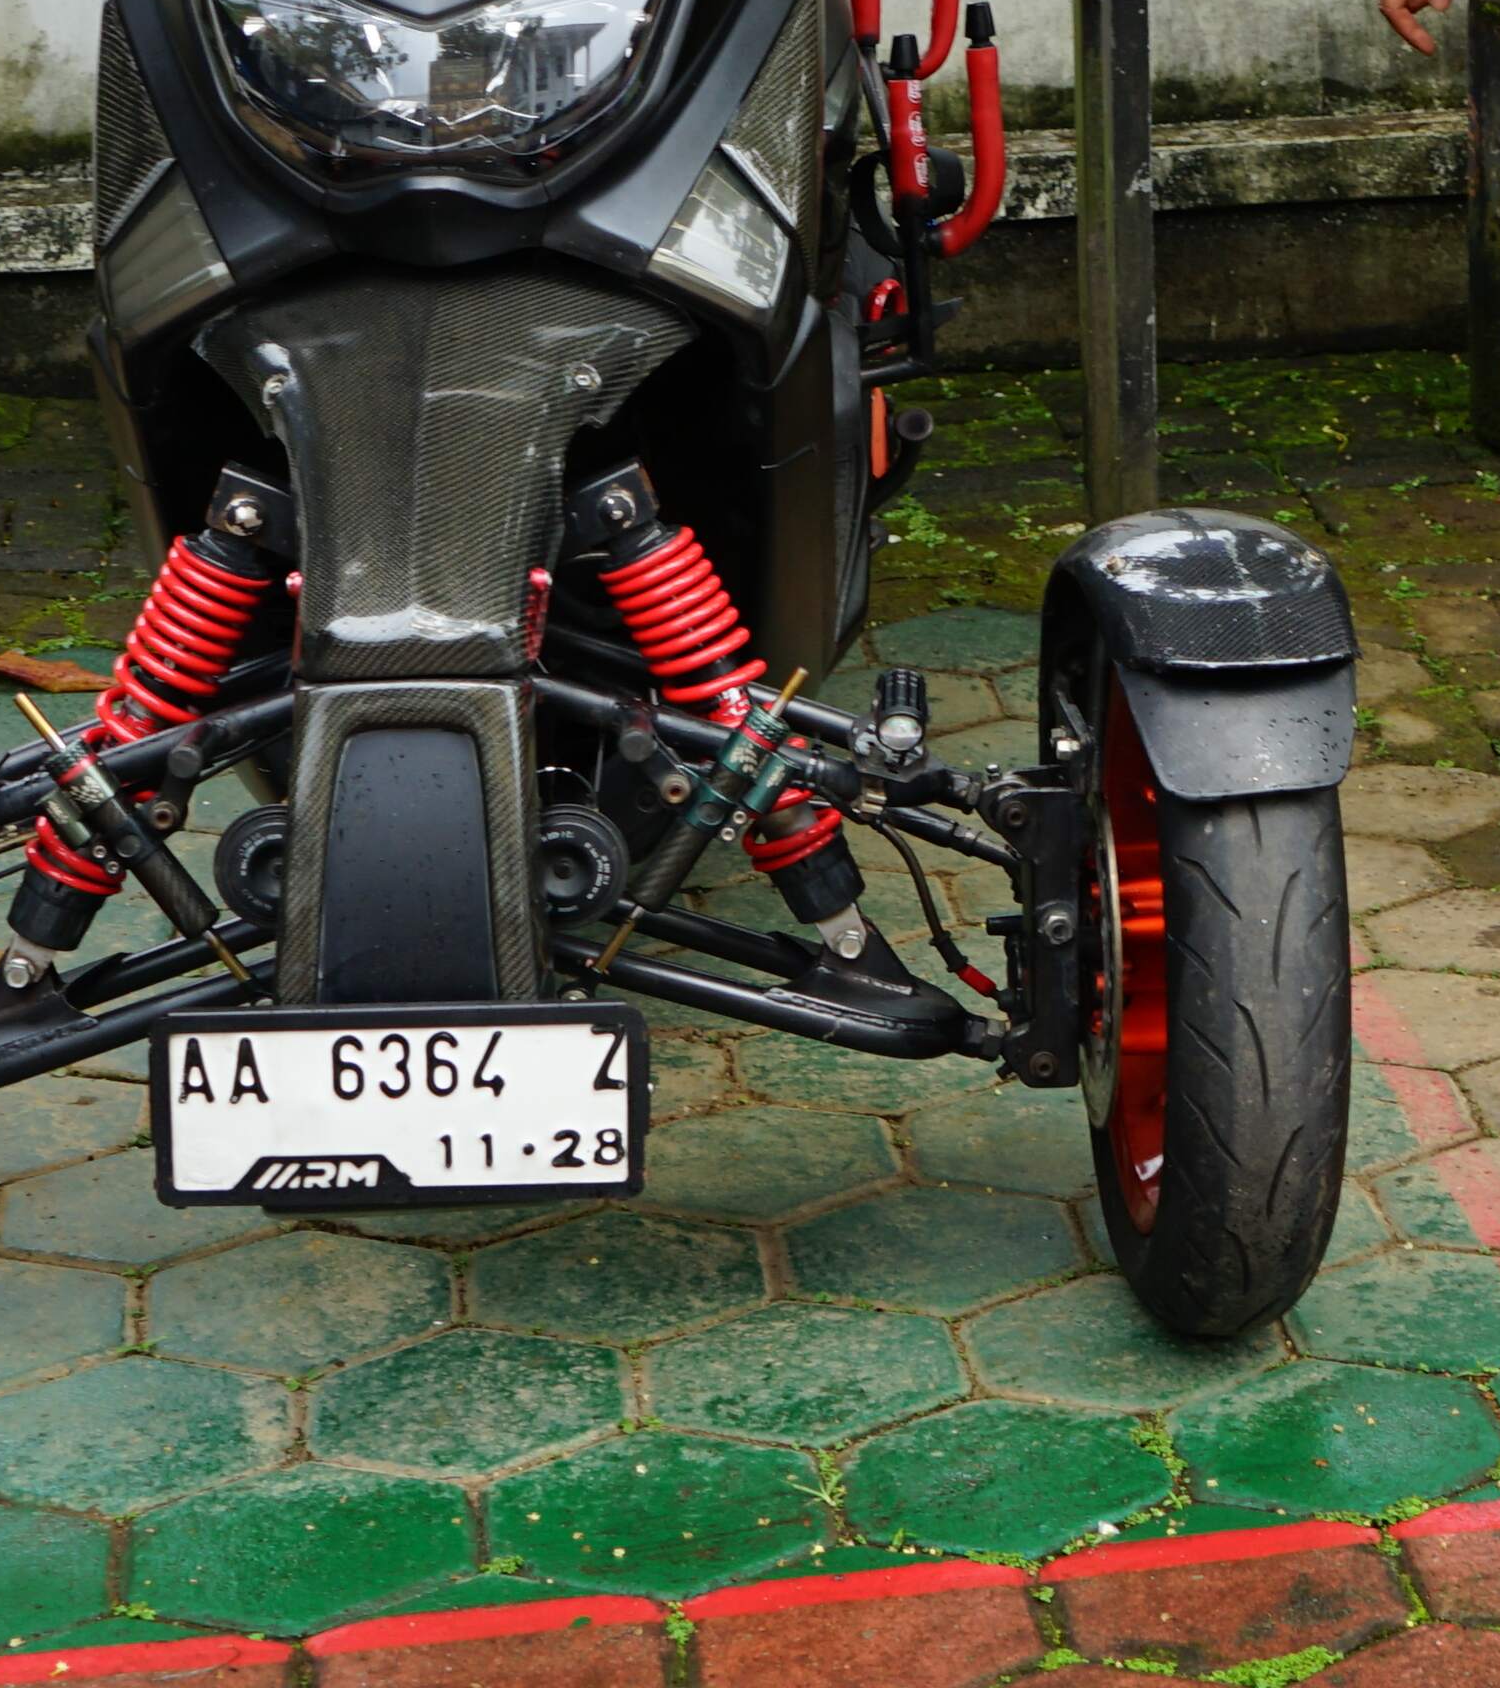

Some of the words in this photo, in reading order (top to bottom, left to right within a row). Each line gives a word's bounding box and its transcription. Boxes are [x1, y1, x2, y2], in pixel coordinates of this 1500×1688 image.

[178, 1036, 270, 1105] AA
[331, 1030, 506, 1101] 6364
[589, 1023, 626, 1092] Z
